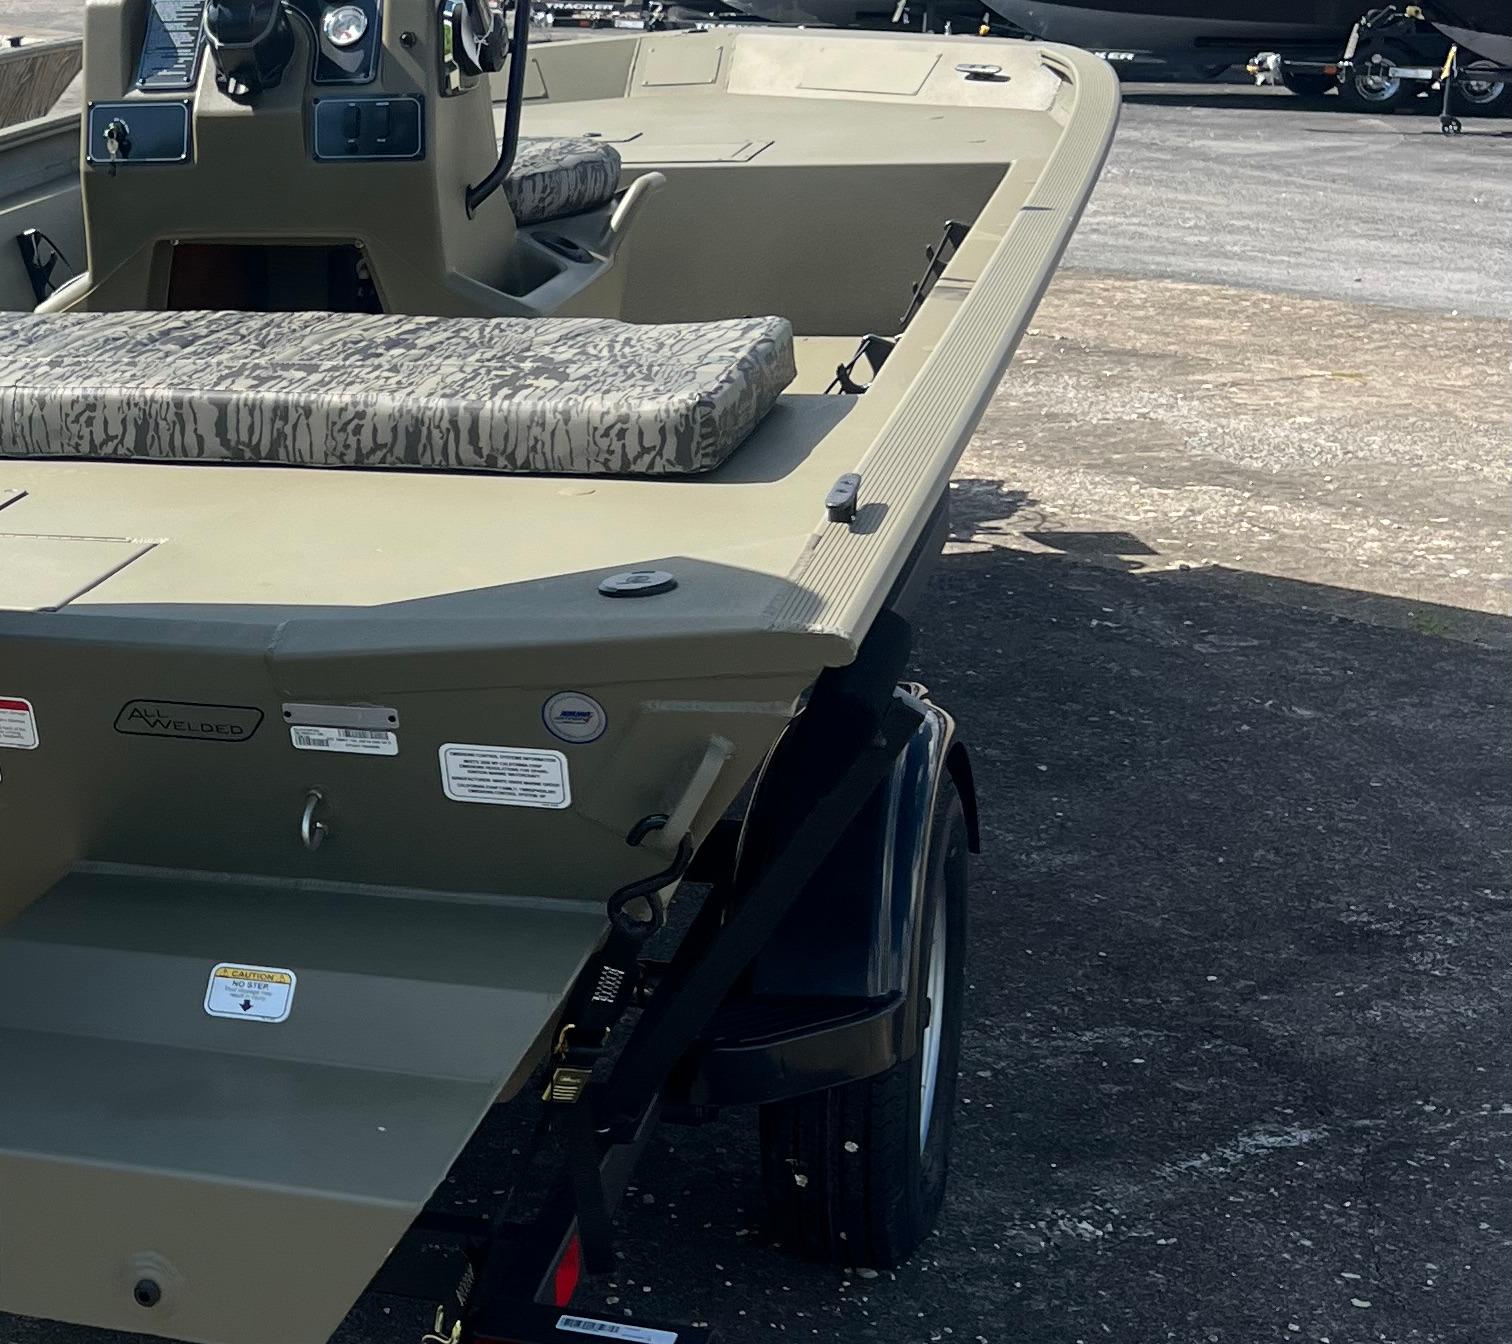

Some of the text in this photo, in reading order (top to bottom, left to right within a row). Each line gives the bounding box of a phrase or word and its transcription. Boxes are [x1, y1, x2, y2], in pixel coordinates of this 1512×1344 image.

[128, 707, 169, 721] ALL
[143, 719, 244, 735] WELDED
[231, 970, 274, 981] CAUTION
[232, 980, 269, 990] NO STEP
